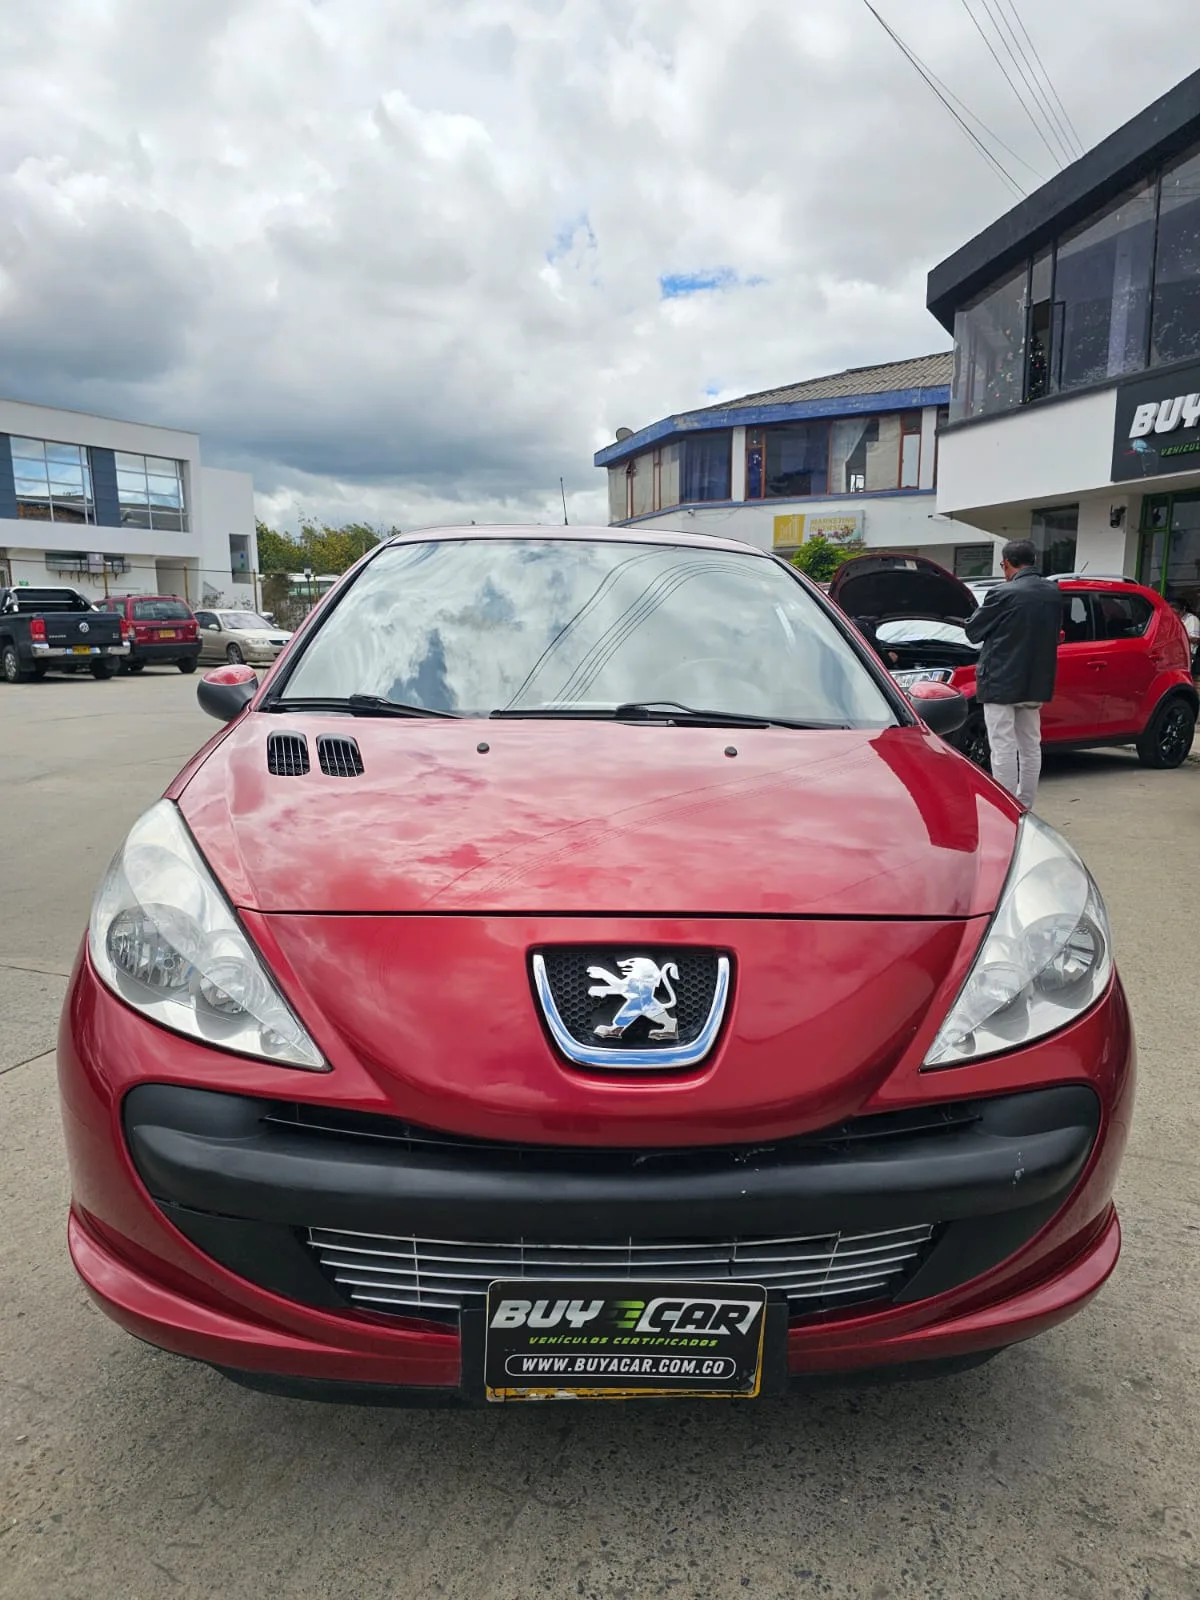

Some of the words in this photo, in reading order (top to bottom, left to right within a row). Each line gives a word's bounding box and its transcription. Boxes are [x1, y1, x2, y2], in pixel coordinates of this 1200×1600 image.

[1129, 393, 1200, 438] BUY
[490, 1299, 605, 1328] BUY
[635, 1297, 763, 1335] CAR
[528, 1334, 608, 1345] VEHÍCULOS
[612, 1336, 719, 1347] CERTIFICADOS
[522, 1357, 725, 1375] WWW.BUYACAR.COM.CO
